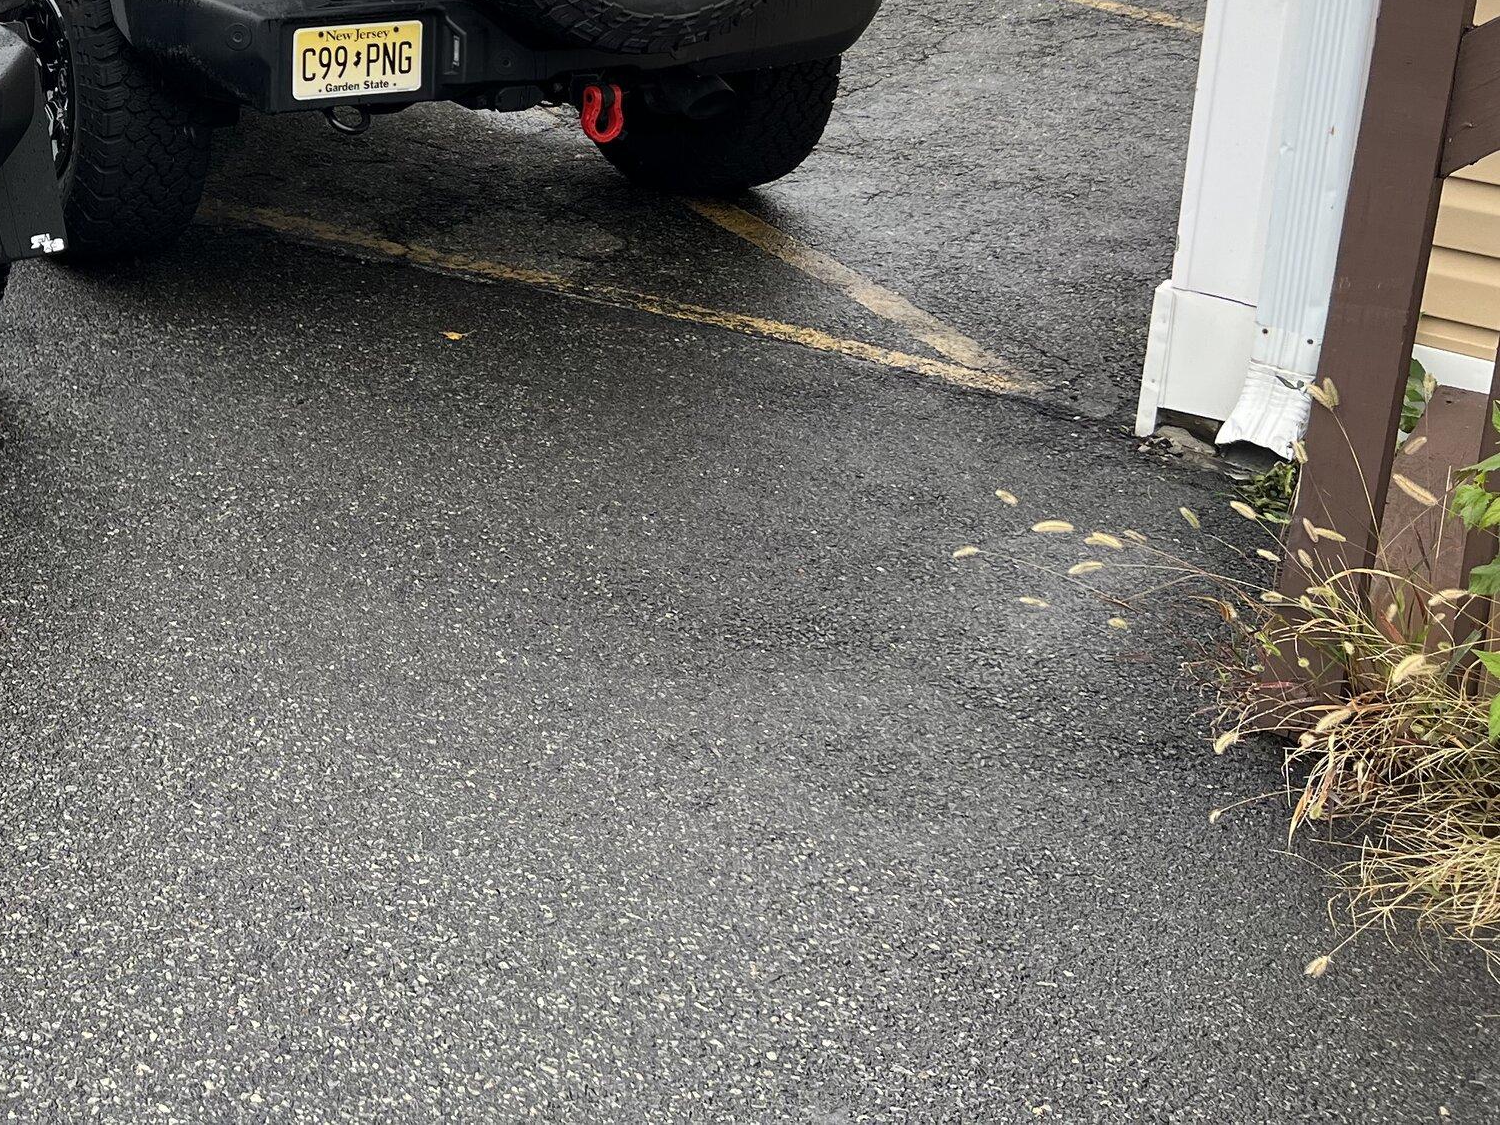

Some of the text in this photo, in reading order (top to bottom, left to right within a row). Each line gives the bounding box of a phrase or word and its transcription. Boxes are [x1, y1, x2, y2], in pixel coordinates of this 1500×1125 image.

[325, 28, 390, 43] New Jersey
[302, 41, 412, 82] C99 PNG
[325, 80, 389, 93] Garden State
